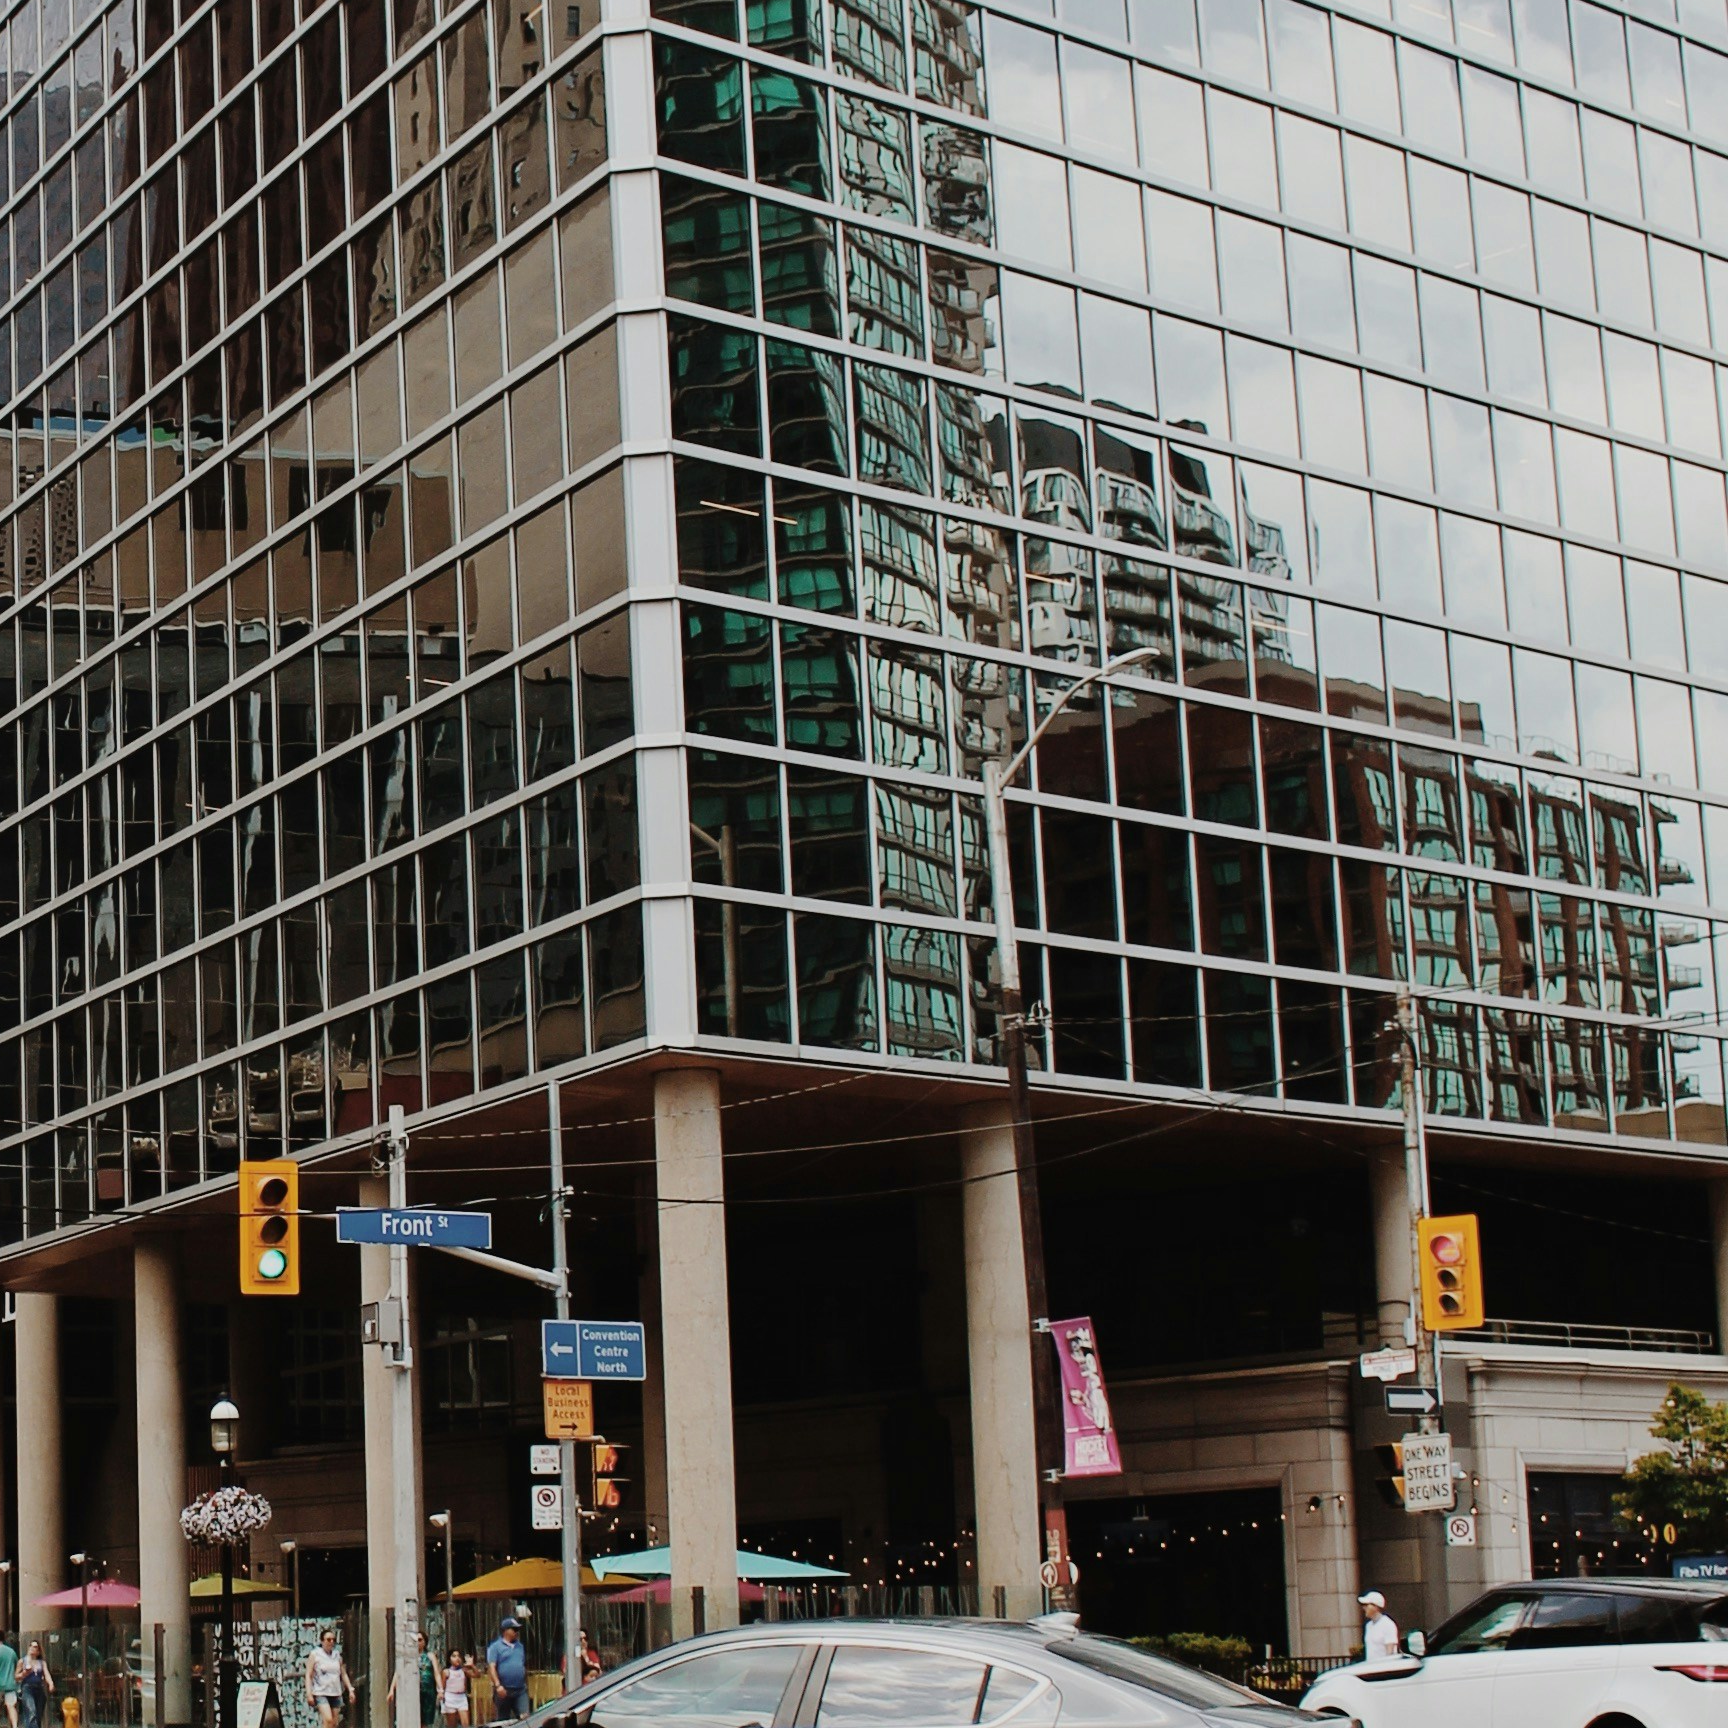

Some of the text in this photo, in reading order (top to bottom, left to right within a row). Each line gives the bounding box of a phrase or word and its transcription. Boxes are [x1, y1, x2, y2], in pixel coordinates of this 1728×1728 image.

[381, 1213, 449, 1236] Front St
[582, 1329, 640, 1342] Convention
[594, 1345, 629, 1357] Centre
[597, 1361, 628, 1372] North
[555, 1386, 580, 1395] Local
[547, 1397, 590, 1407] Business
[553, 1410, 586, 1419] Access
[1405, 1445, 1447, 1462] ONE WAY
[1407, 1464, 1447, 1481] STREET
[1408, 1483, 1449, 1500] BEGINS
[1700, 1565, 1713, 1576] TV
